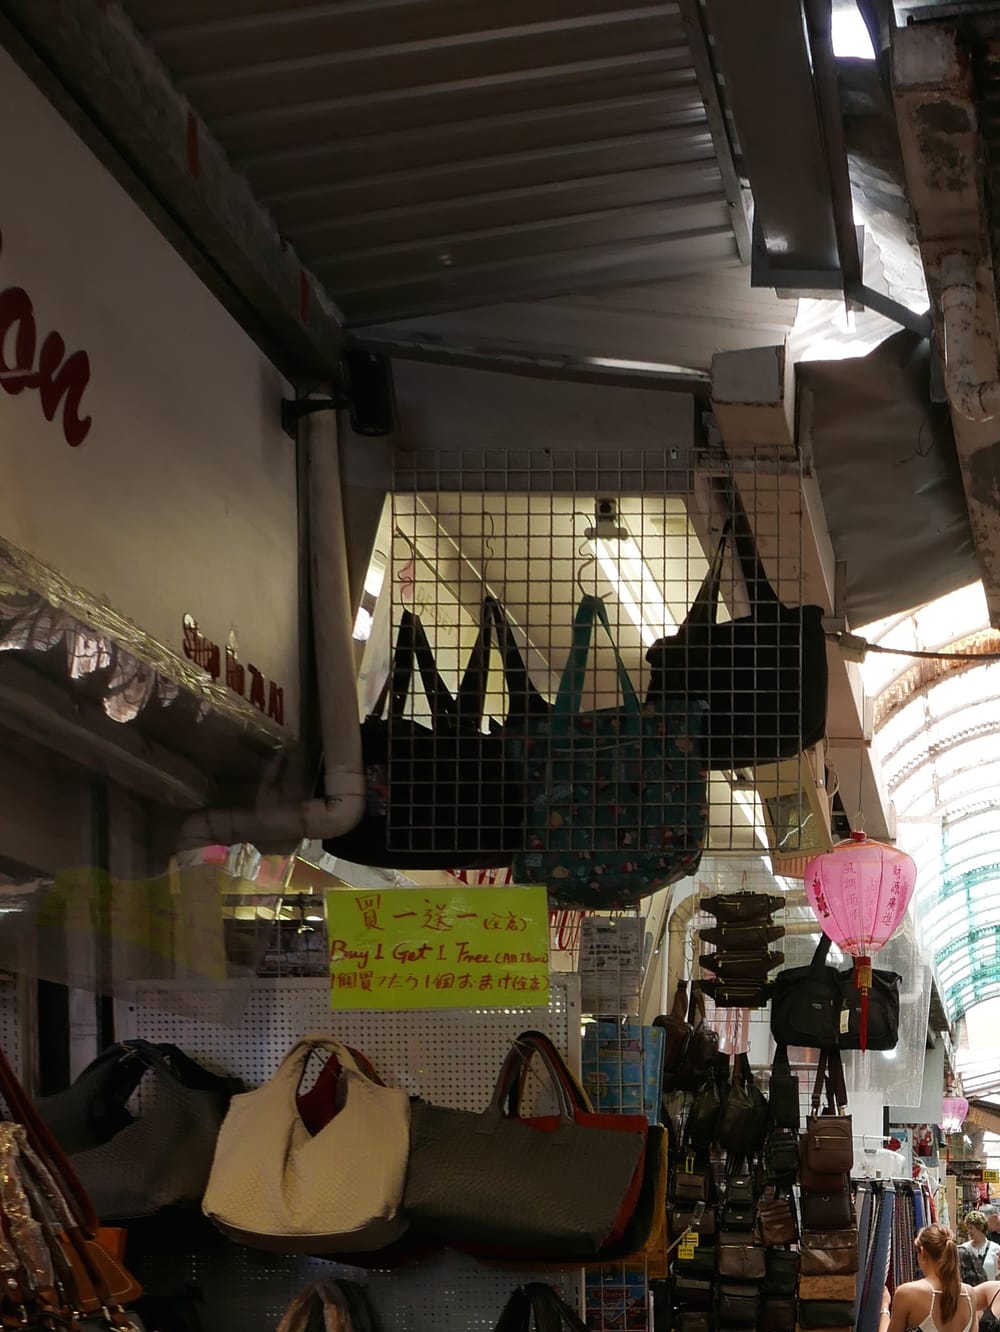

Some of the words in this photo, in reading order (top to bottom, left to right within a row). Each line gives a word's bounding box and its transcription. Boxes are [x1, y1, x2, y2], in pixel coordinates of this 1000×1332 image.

[330, 940, 370, 969] Buy
[392, 942, 433, 963] Get
[456, 941, 492, 964] Free
